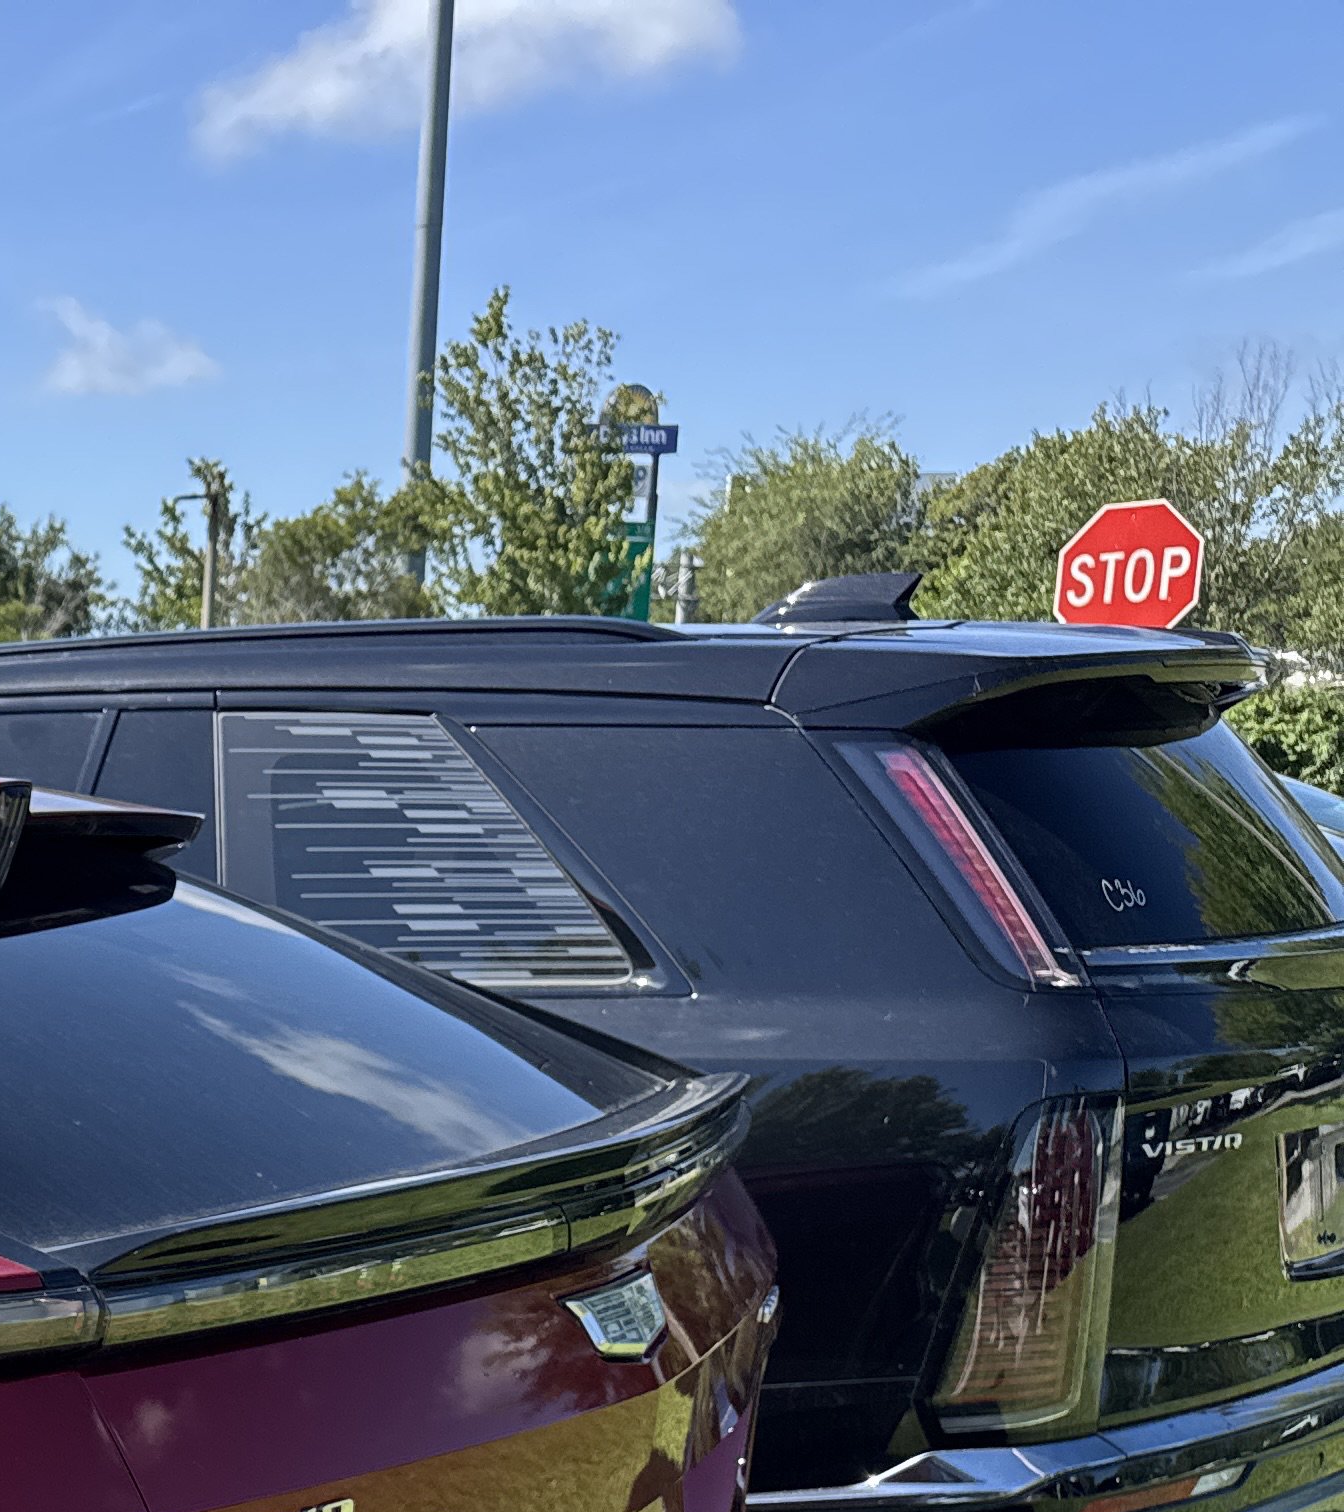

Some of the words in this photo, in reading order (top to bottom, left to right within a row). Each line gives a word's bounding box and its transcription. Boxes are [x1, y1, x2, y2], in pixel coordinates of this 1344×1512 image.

[640, 425, 667, 445] Inn
[1066, 546, 1192, 608] STOP
[1101, 878, 1146, 912] C36
[1141, 1133, 1243, 1158] VISTIQ
